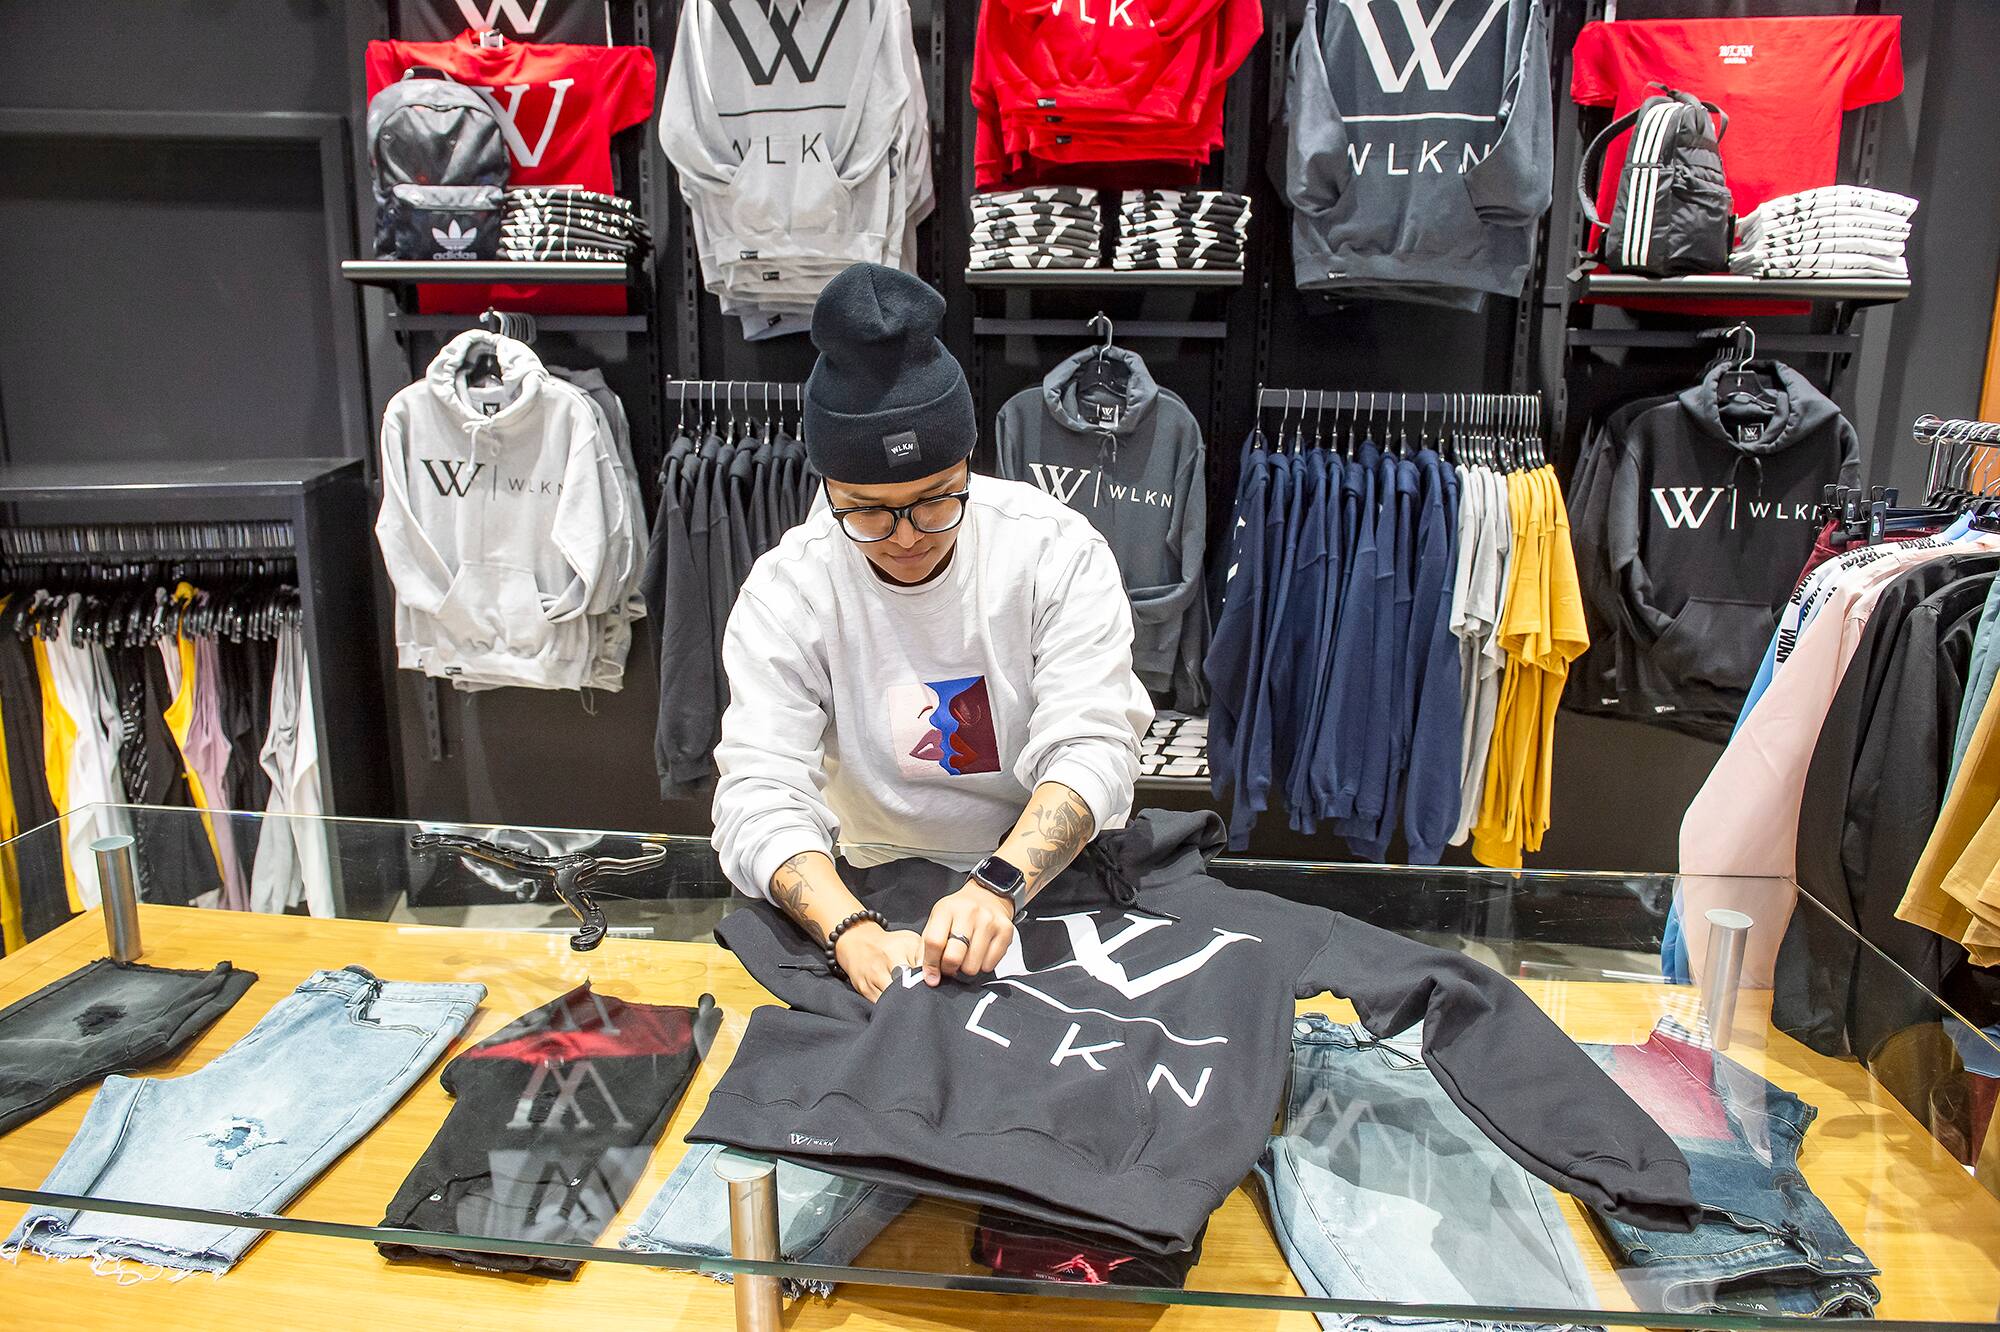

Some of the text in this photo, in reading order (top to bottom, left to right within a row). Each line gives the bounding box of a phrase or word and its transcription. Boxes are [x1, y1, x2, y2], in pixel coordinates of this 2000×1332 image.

[1338, 0, 1510, 93] W
[432, 249, 478, 260] adidas
[890, 442, 914, 455] WLKN
[420, 458, 486, 498] W
[1028, 463, 1173, 509] W WLKN
[1650, 487, 1726, 530] W
